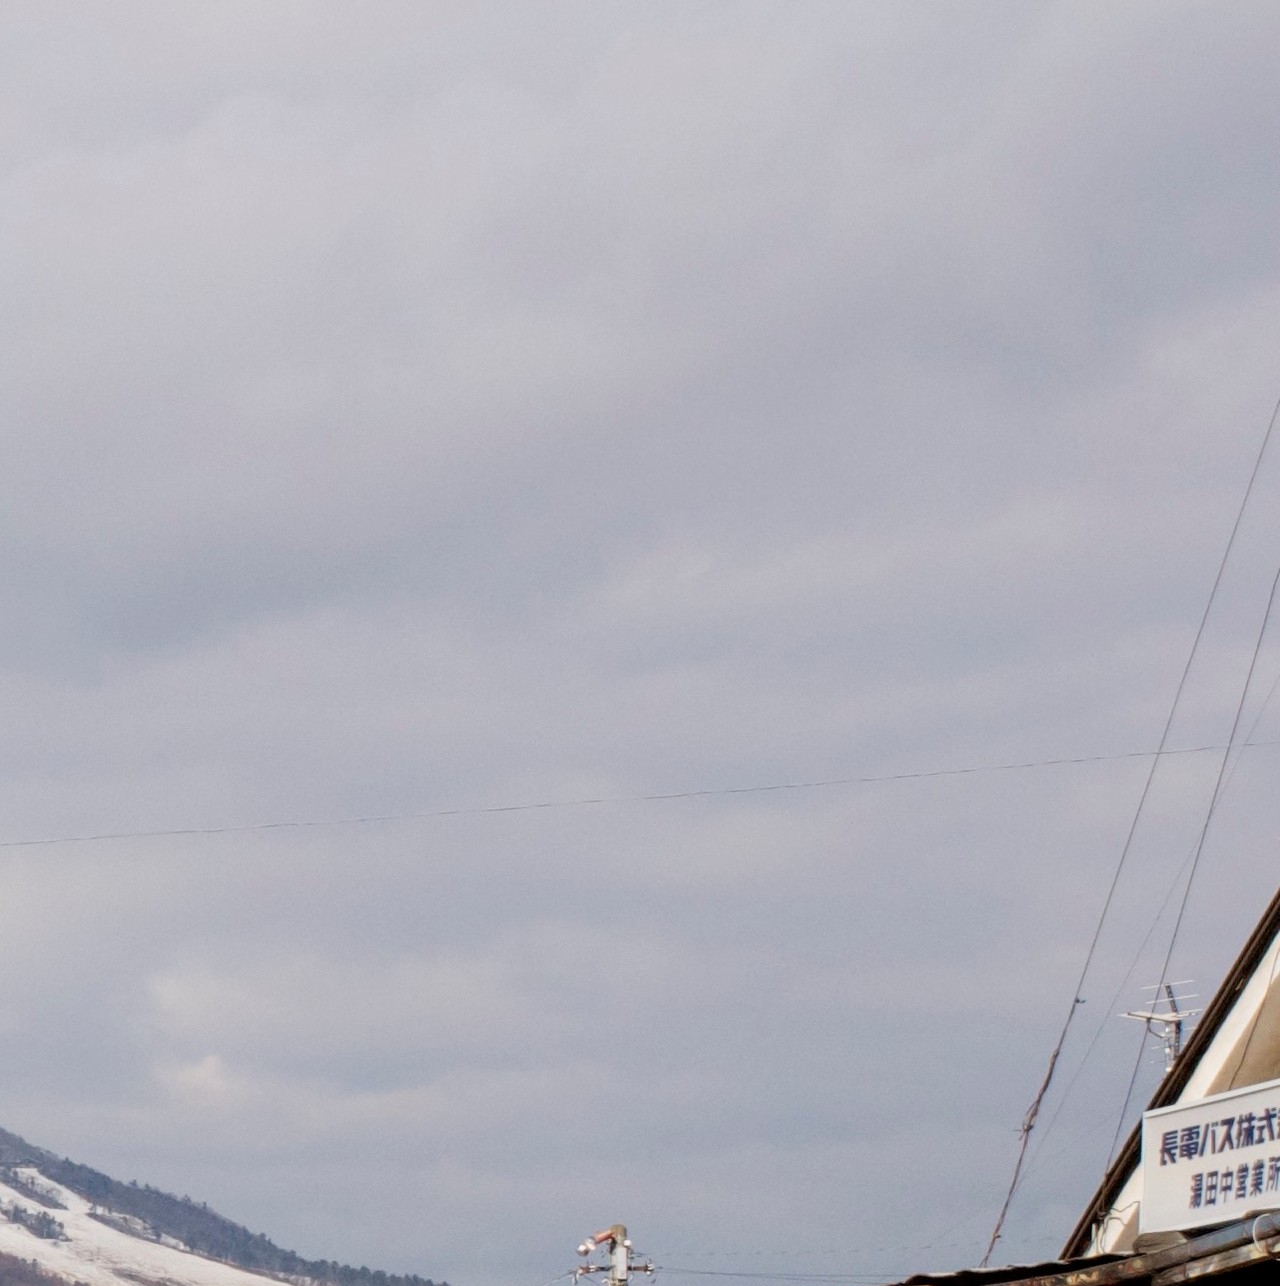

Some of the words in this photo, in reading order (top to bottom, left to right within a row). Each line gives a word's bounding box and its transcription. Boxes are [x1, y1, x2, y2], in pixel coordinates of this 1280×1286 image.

[1159, 1106, 1280, 1167] 長電バス株式
